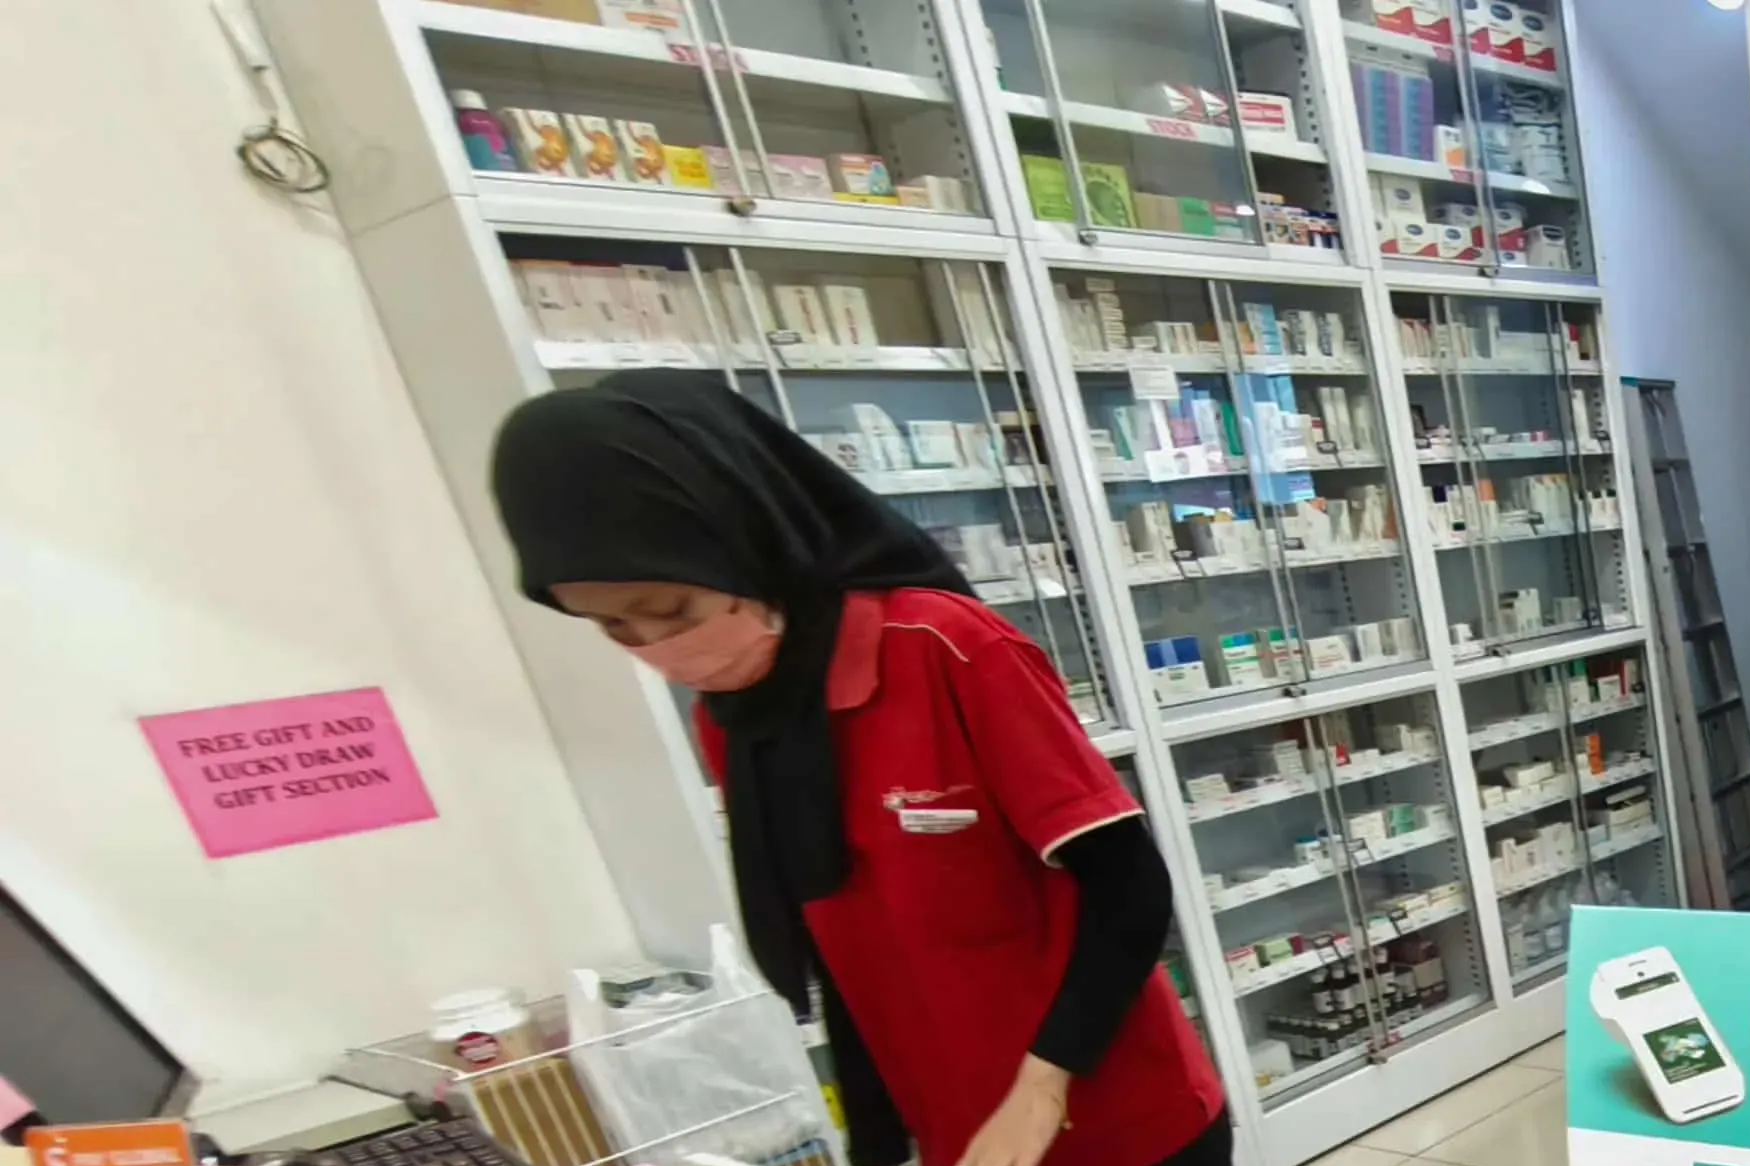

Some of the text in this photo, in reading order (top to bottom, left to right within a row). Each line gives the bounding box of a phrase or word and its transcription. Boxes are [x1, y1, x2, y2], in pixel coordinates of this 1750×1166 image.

[178, 716, 375, 757] FREE GIFT AND
[202, 742, 375, 783] LUCKY DRAW
[214, 768, 391, 809] GIFT SECTION
